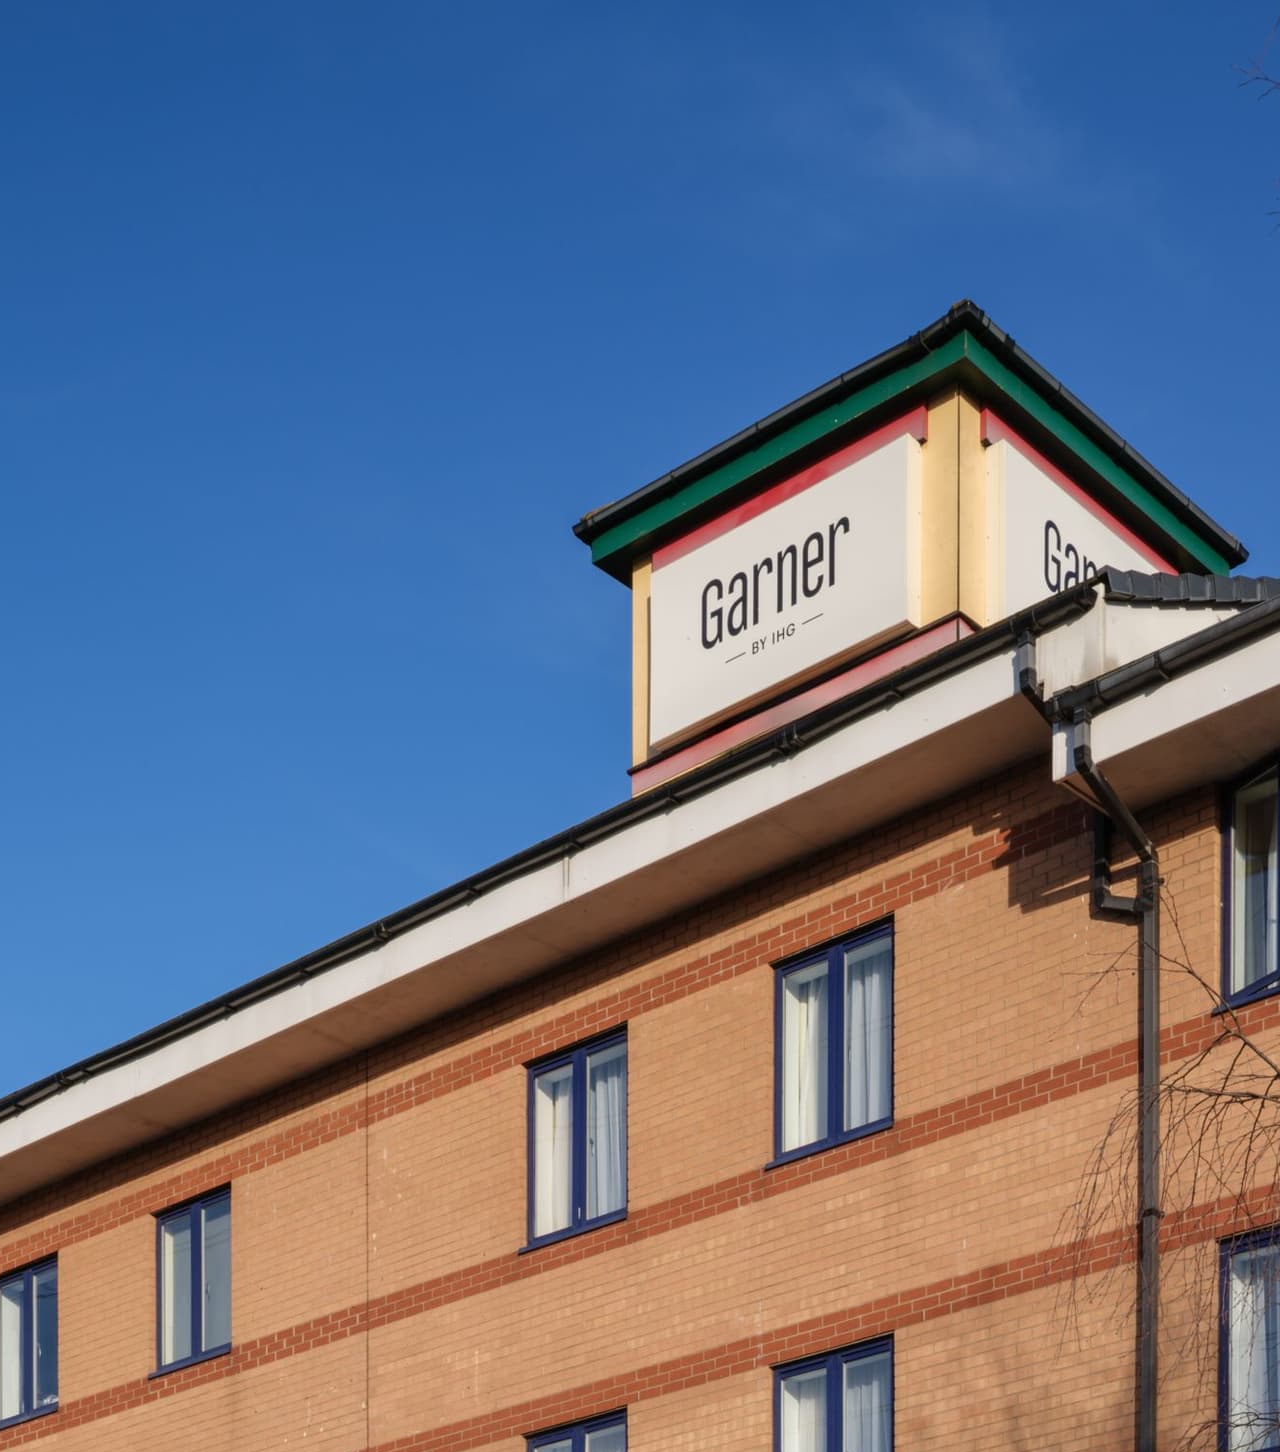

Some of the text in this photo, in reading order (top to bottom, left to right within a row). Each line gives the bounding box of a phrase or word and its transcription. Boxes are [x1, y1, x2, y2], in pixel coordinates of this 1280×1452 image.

[701, 516, 850, 650] Garner
[751, 623, 796, 655] BY IHG
